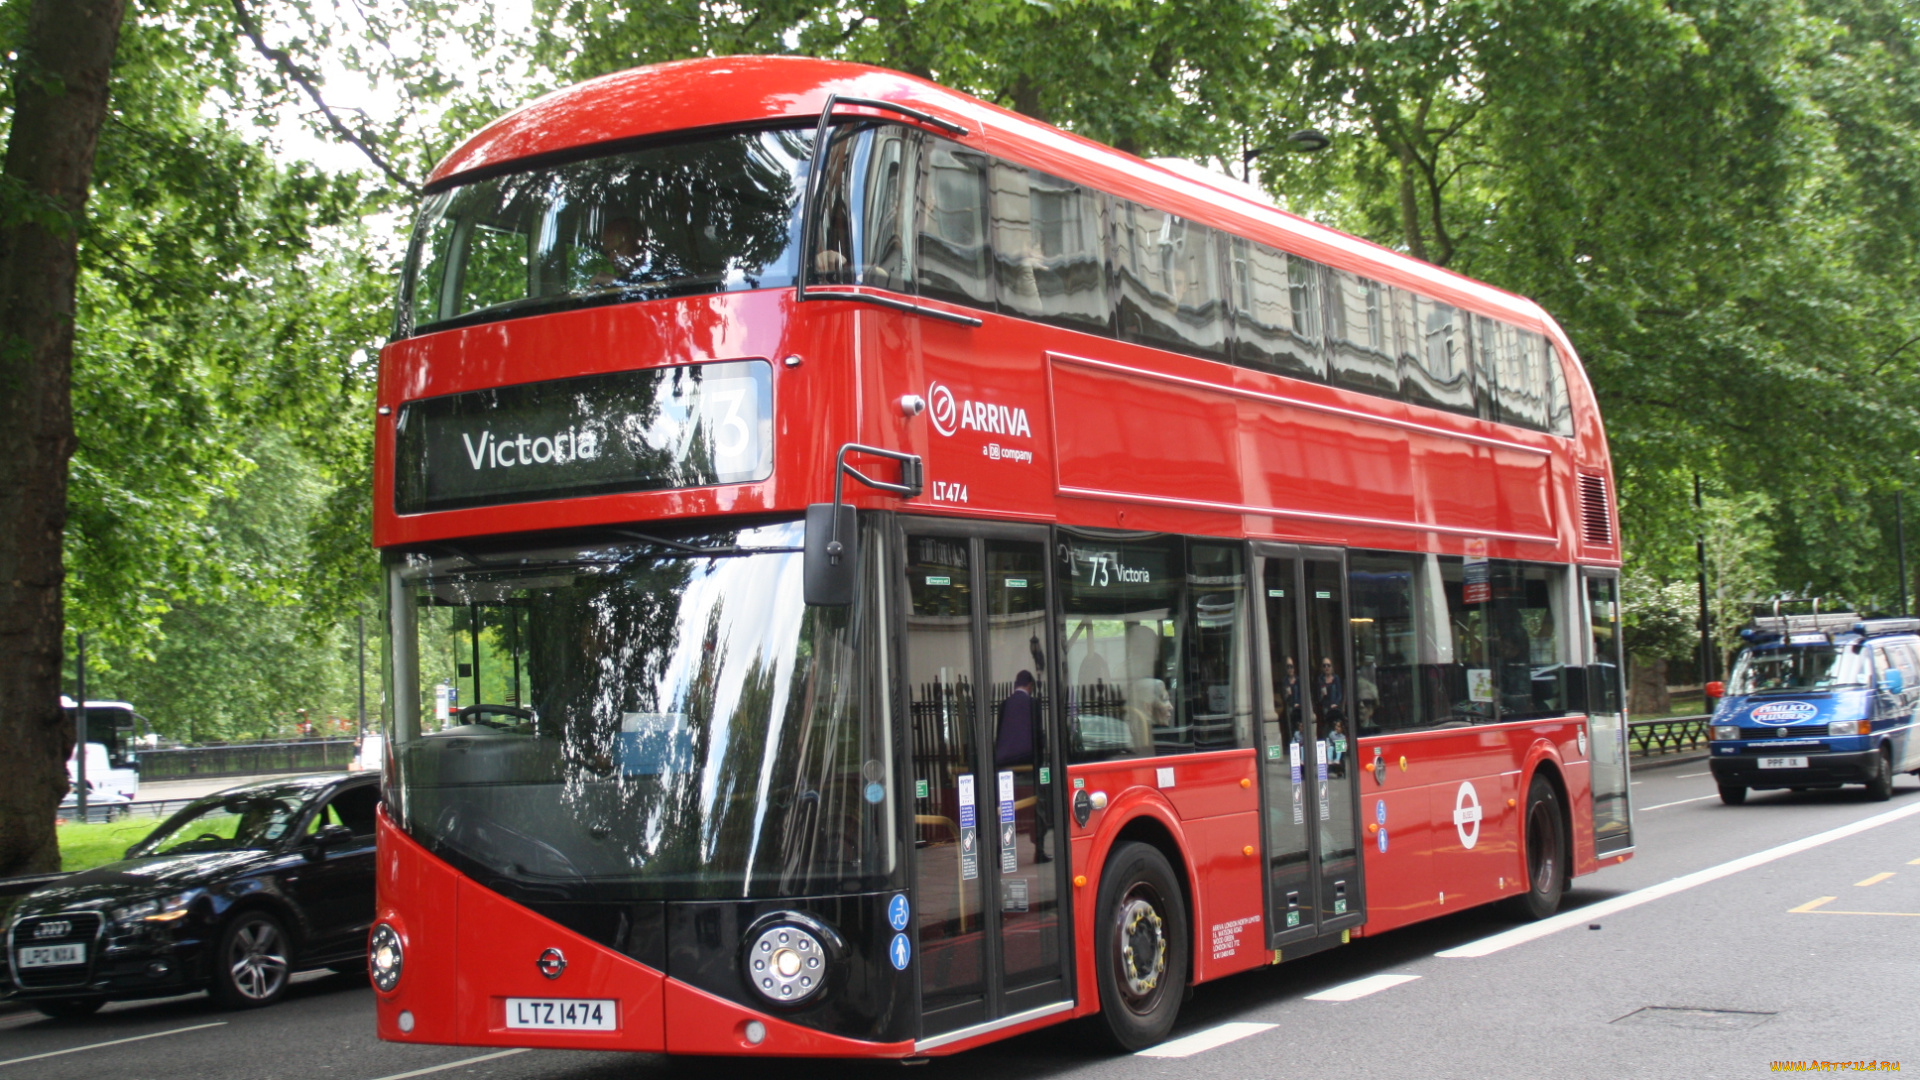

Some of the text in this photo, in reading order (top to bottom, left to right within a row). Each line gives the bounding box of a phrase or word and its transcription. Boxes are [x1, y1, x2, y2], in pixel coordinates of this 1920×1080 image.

[462, 388, 750, 470] Victoria 73
[961, 400, 1031, 438] ARRIVA
[983, 444, 1032, 464] a DB company
[933, 481, 968, 503] LT474
[1089, 556, 1150, 587] 73 Victoria
[25, 948, 50, 965] LP2
